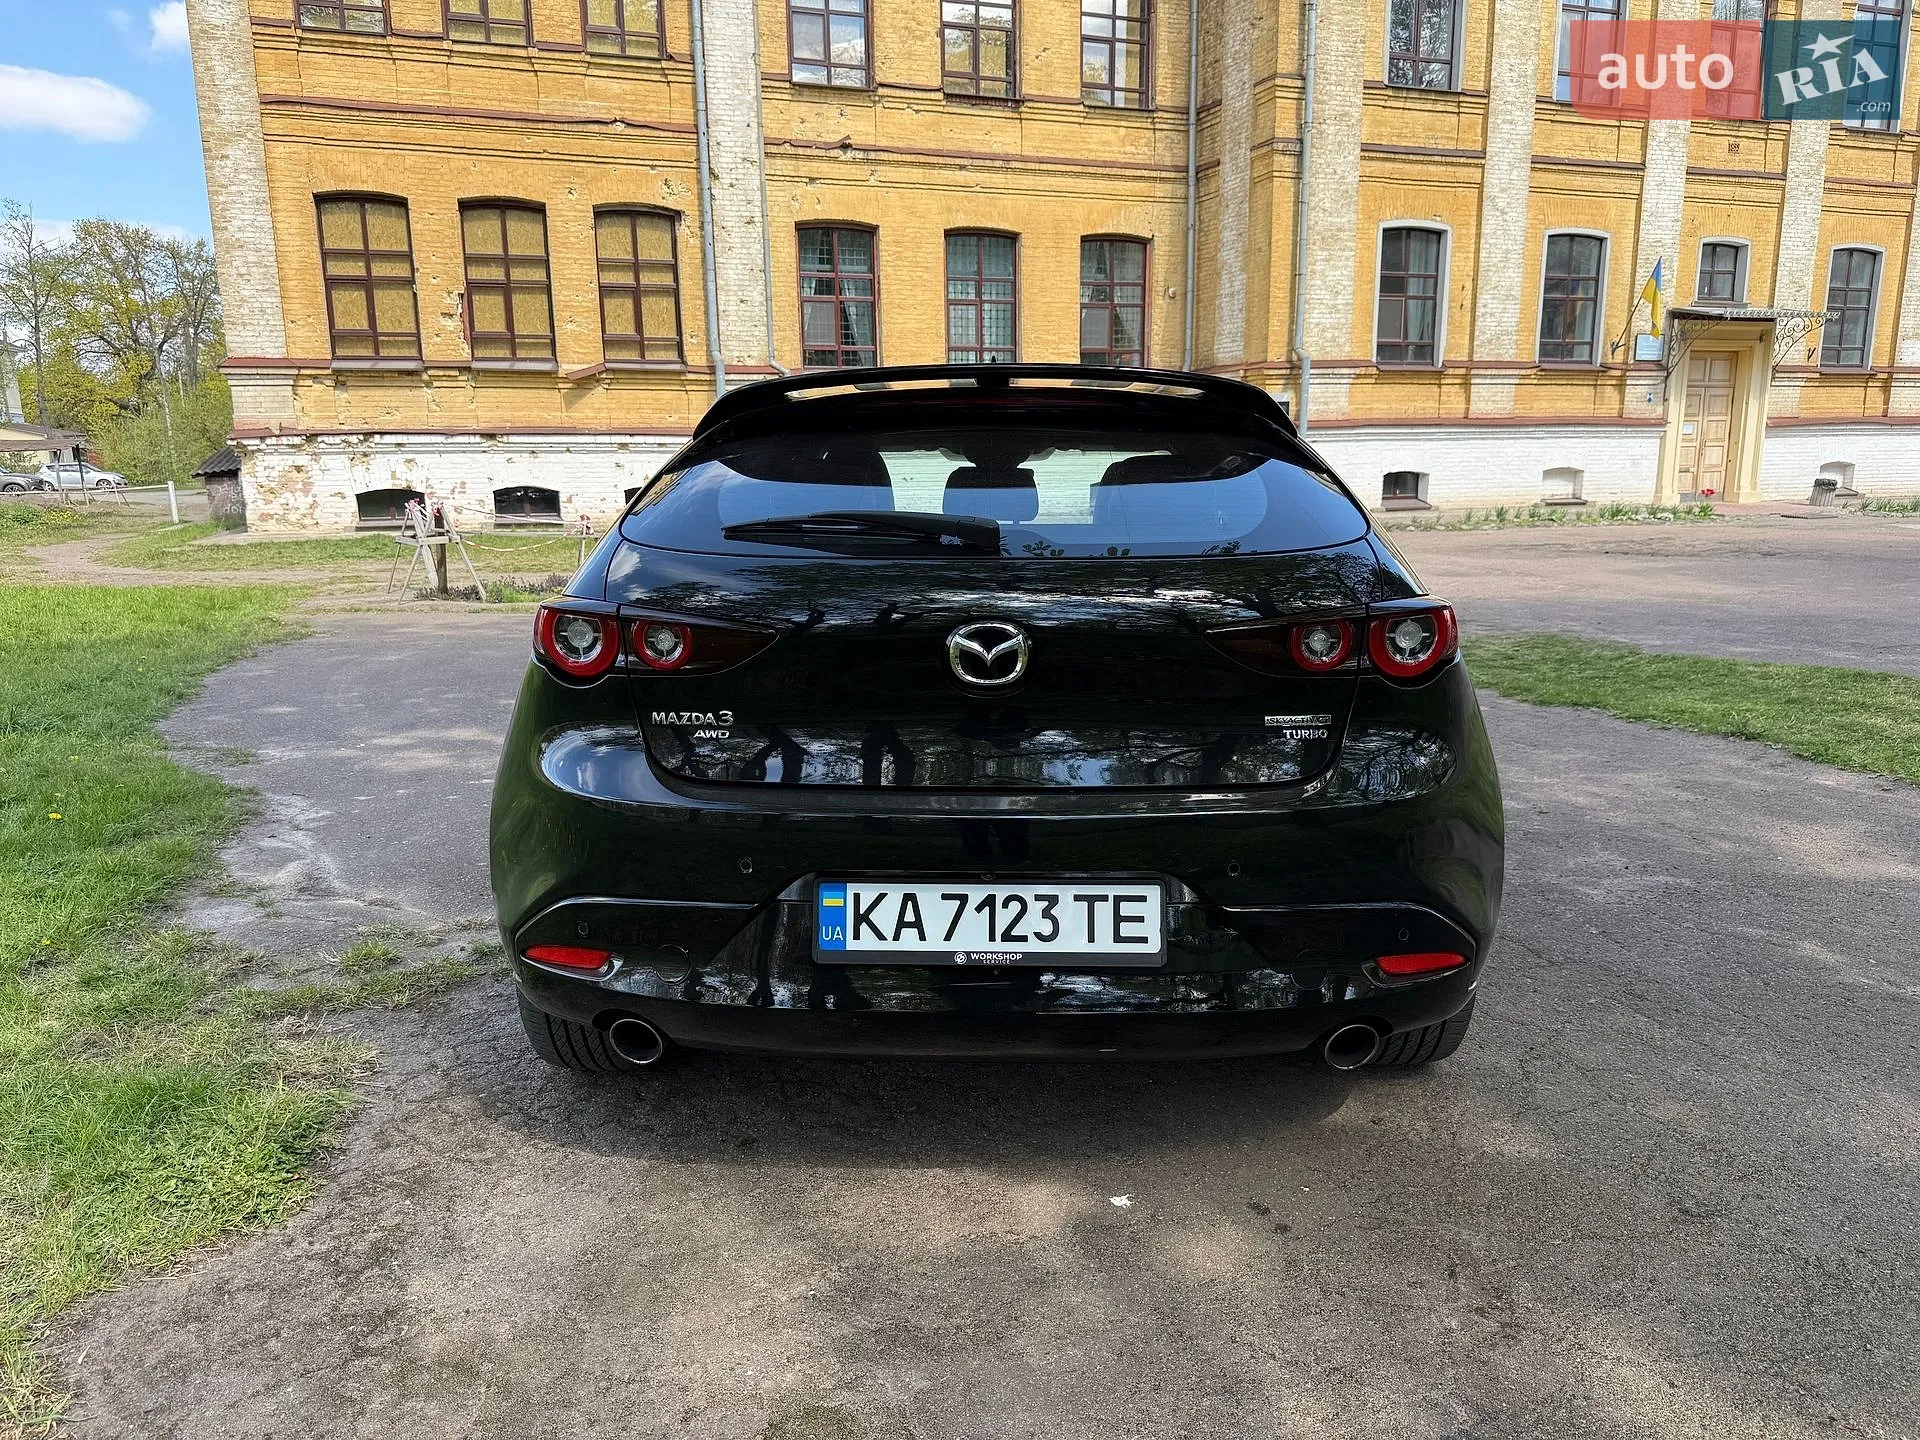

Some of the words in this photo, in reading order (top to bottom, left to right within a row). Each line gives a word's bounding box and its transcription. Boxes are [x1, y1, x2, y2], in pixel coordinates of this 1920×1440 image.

[693, 729, 730, 739] AWD
[1282, 729, 1329, 739] TURBO
[851, 892, 927, 942] KA
[940, 893, 1060, 943] 7123
[1073, 894, 1149, 944] TE
[822, 925, 844, 941] UA
[970, 952, 1023, 960] WORKSHOP
